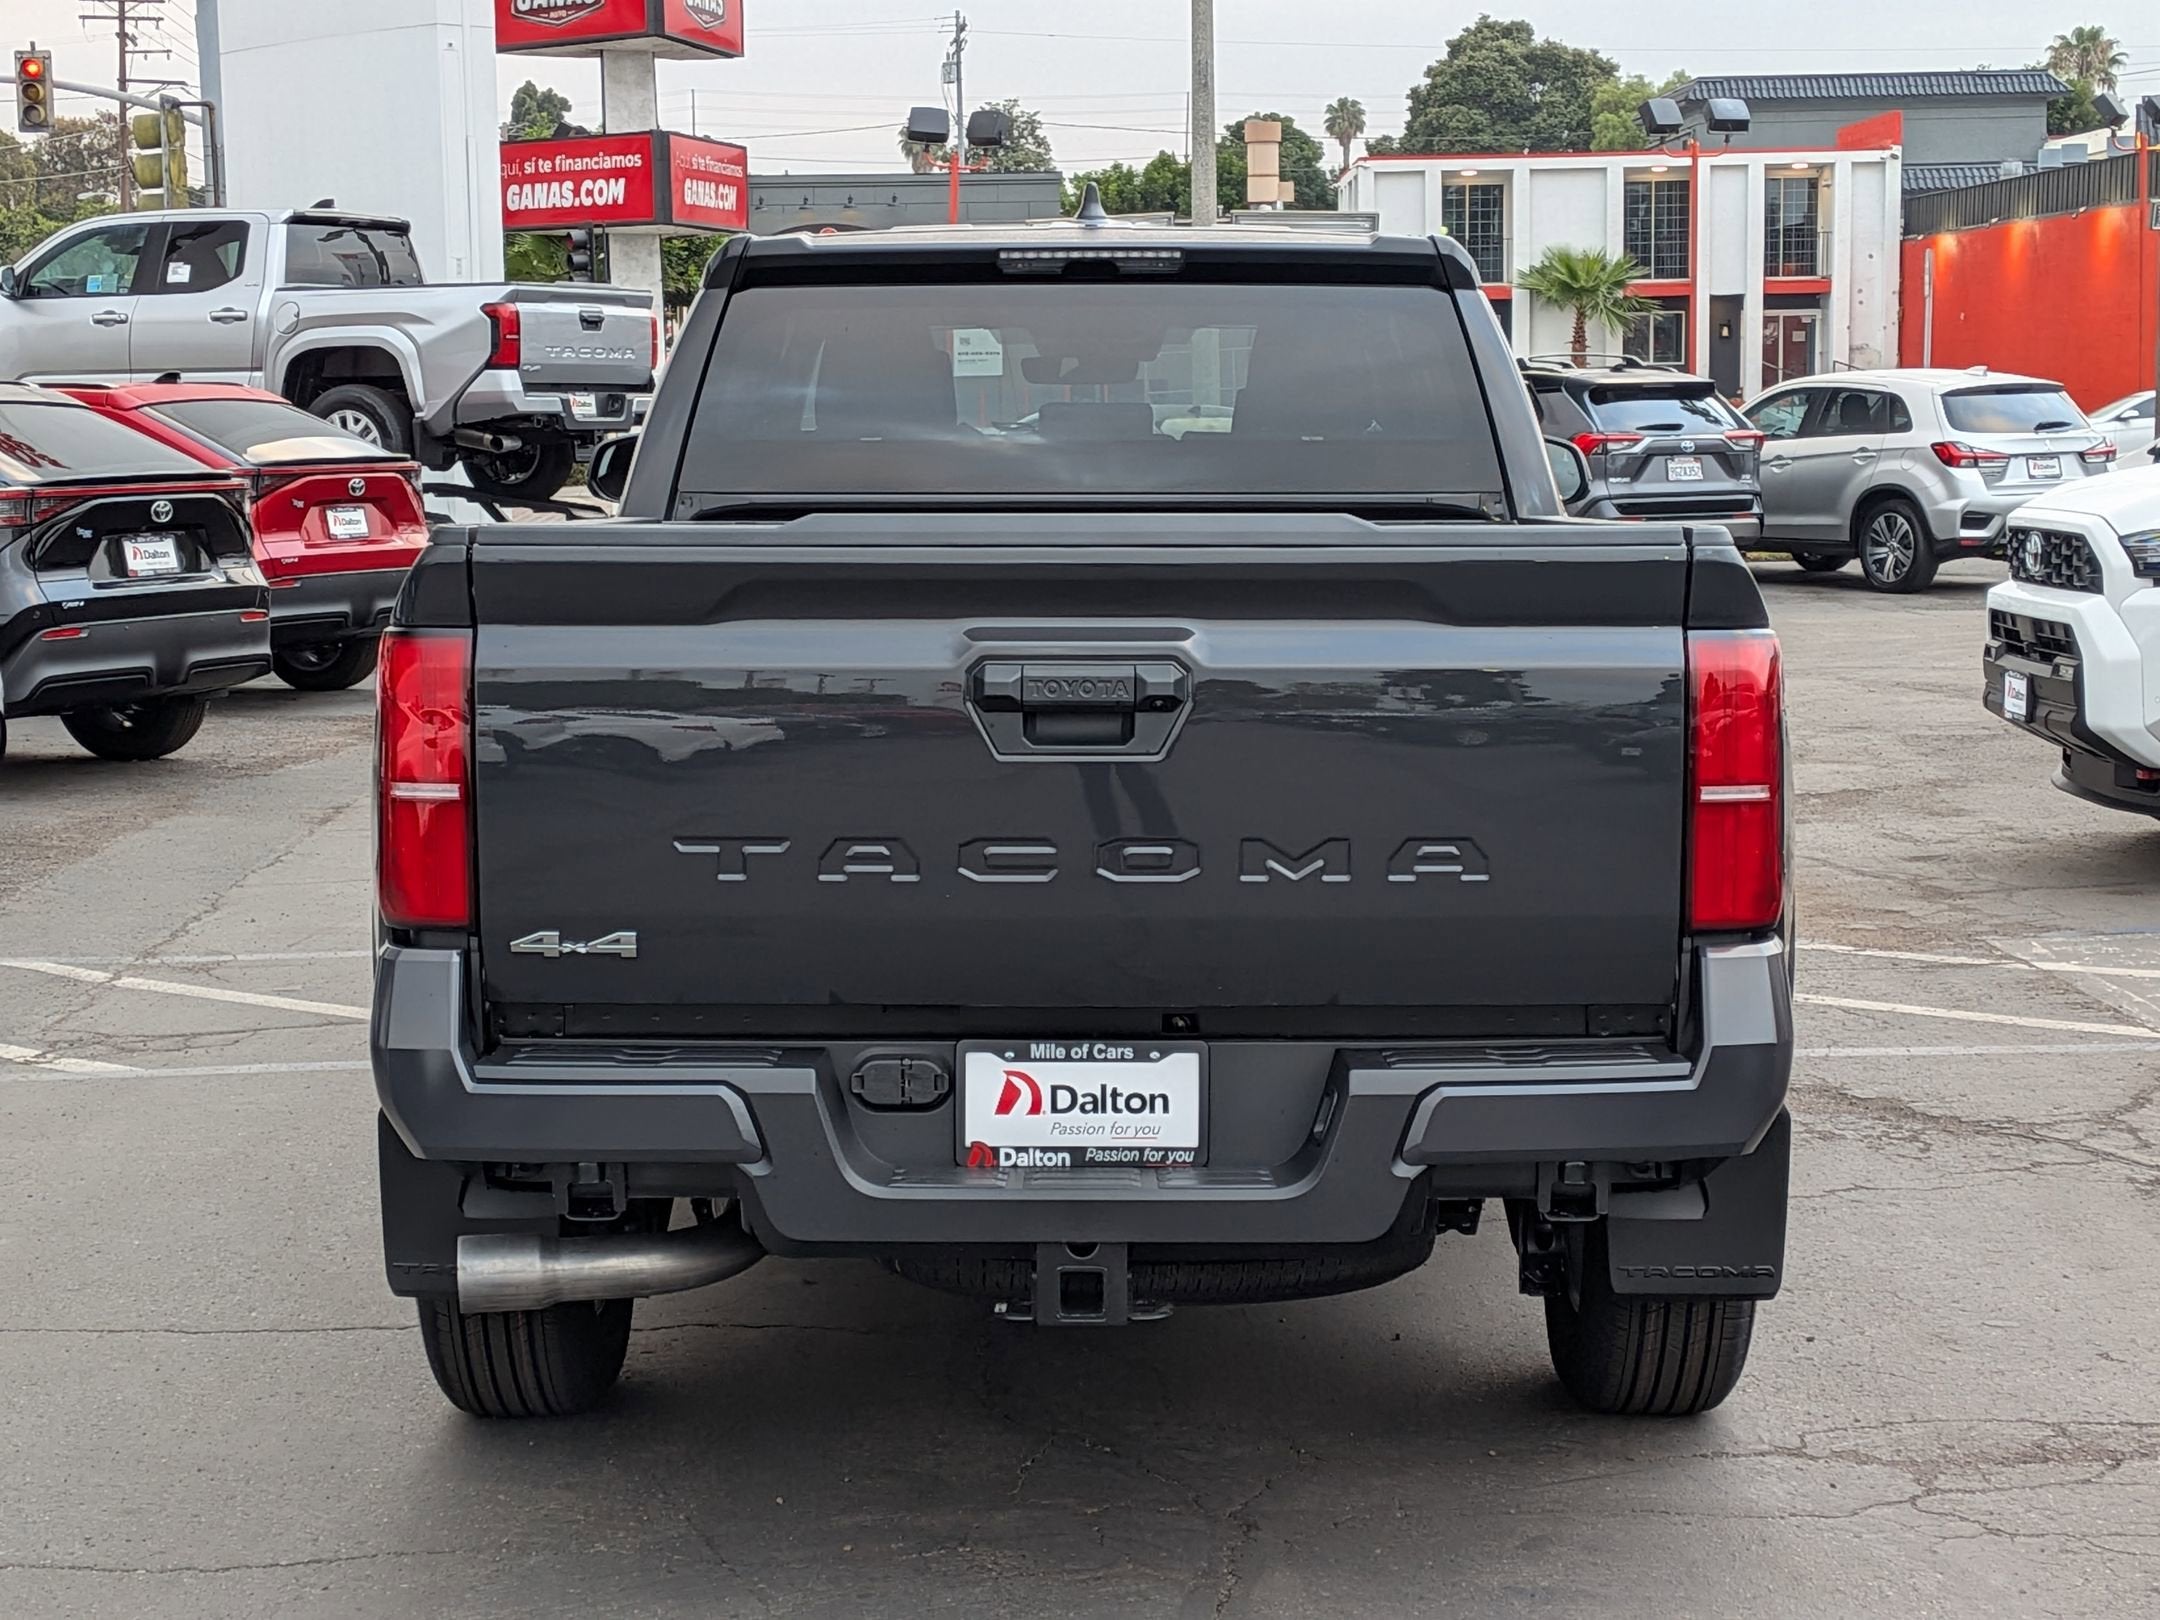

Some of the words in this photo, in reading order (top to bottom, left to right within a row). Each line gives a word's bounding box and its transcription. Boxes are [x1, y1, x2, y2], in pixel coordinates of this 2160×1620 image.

[500, 159, 522, 179] quí,
[538, 158, 553, 174] te
[555, 152, 643, 172] financiamos
[506, 177, 626, 212] GANAS.COM
[684, 177, 738, 212] GANAS.COM
[545, 345, 637, 360] TACOMA
[143, 548, 171, 560] Dalton
[1027, 679, 1131, 699] TOYOTA
[672, 836, 1491, 883] TACOMA
[1030, 1043, 1066, 1059] Mile
[1070, 1043, 1091, 1059] of
[1093, 1043, 1135, 1060] Cars
[1050, 1083, 1171, 1115] Dalton
[1050, 1122, 1105, 1136] Passion
[1109, 1121, 1133, 1137] for
[1134, 1124, 1161, 1137] you
[1000, 1147, 1071, 1167] Dalton
[1085, 1148, 1140, 1163] Passion
[1142, 1148, 1166, 1164] for
[1166, 1151, 1195, 1165] you
[1616, 1265, 1777, 1280] TACOMA
